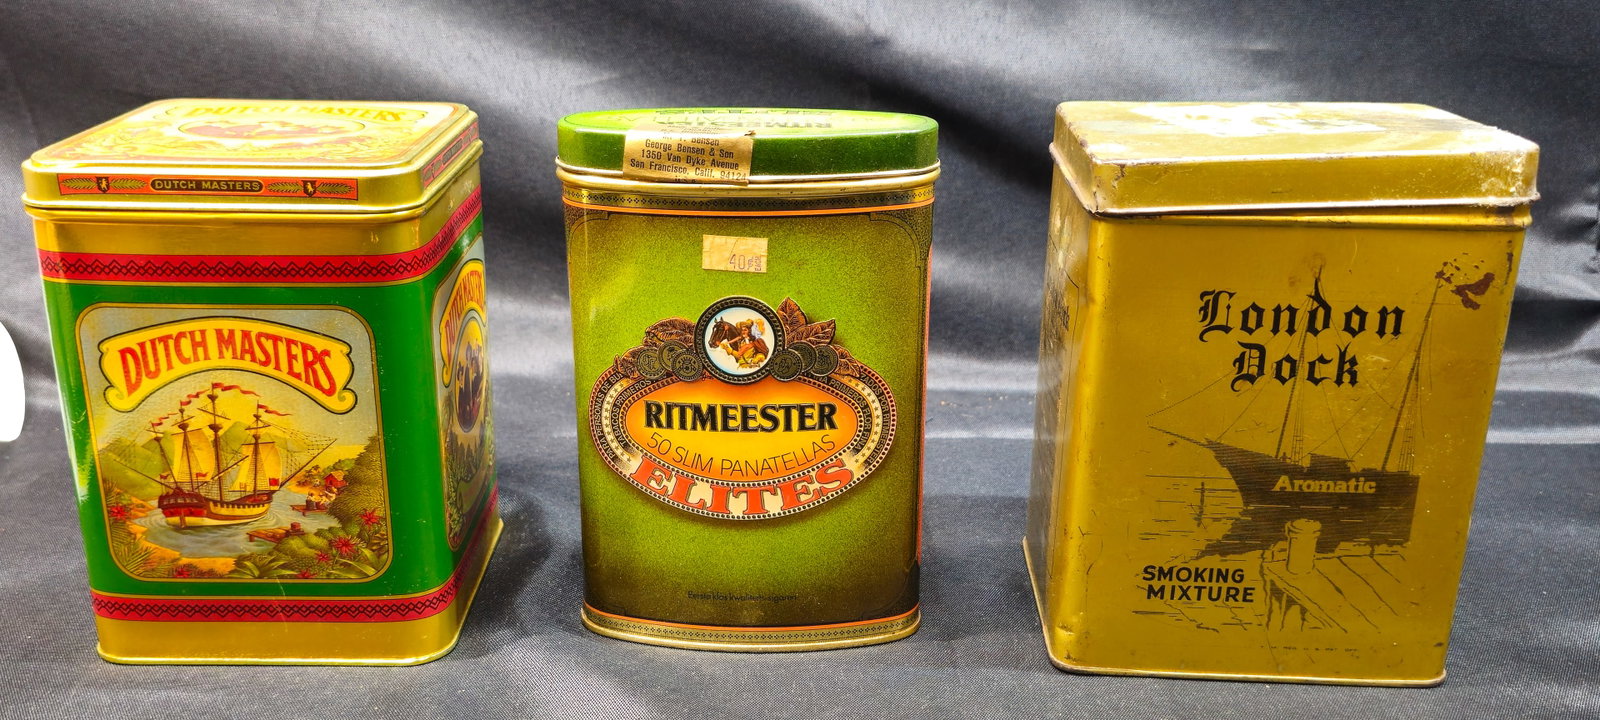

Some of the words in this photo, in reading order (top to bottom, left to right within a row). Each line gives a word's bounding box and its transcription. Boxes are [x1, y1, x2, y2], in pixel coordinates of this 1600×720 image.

[640, 149, 662, 160] 1350
[667, 153, 682, 163] Van
[686, 155, 706, 167] Dyke
[710, 158, 739, 170] Avenue
[645, 138, 672, 152] George
[677, 143, 705, 156] Bensen
[708, 147, 716, 157] &
[719, 149, 734, 159] Son
[630, 159, 645, 169] San
[720, 170, 747, 181] 94124
[154, 180, 198, 190] DUTCH
[202, 180, 261, 191] MASTERS
[1198, 277, 1406, 343] London
[118, 328, 212, 398] DUTCH
[213, 328, 338, 398] MASTERS
[1230, 340, 1360, 393] Dock
[601, 382, 612, 393] DE
[617, 380, 652, 407] PRIMEROS
[830, 378, 867, 408] PRIMEROS
[594, 391, 605, 438] PERSONAS
[878, 395, 890, 413] POR
[611, 406, 627, 447] TABACOS
[643, 399, 840, 433] RITMEESTER
[862, 408, 873, 431] FLOR
[600, 438, 616, 459] PARA
[854, 431, 870, 451] FINA
[868, 413, 890, 464] RITMEESTER
[646, 431, 672, 456] 50
[672, 446, 714, 474] SLIM
[720, 434, 836, 477] PANATELLAS
[629, 454, 855, 515] ELITES
[1271, 475, 1377, 494] Aromatic
[1142, 565, 1245, 584] SMOKING
[1146, 585, 1256, 603] MIXTURE
